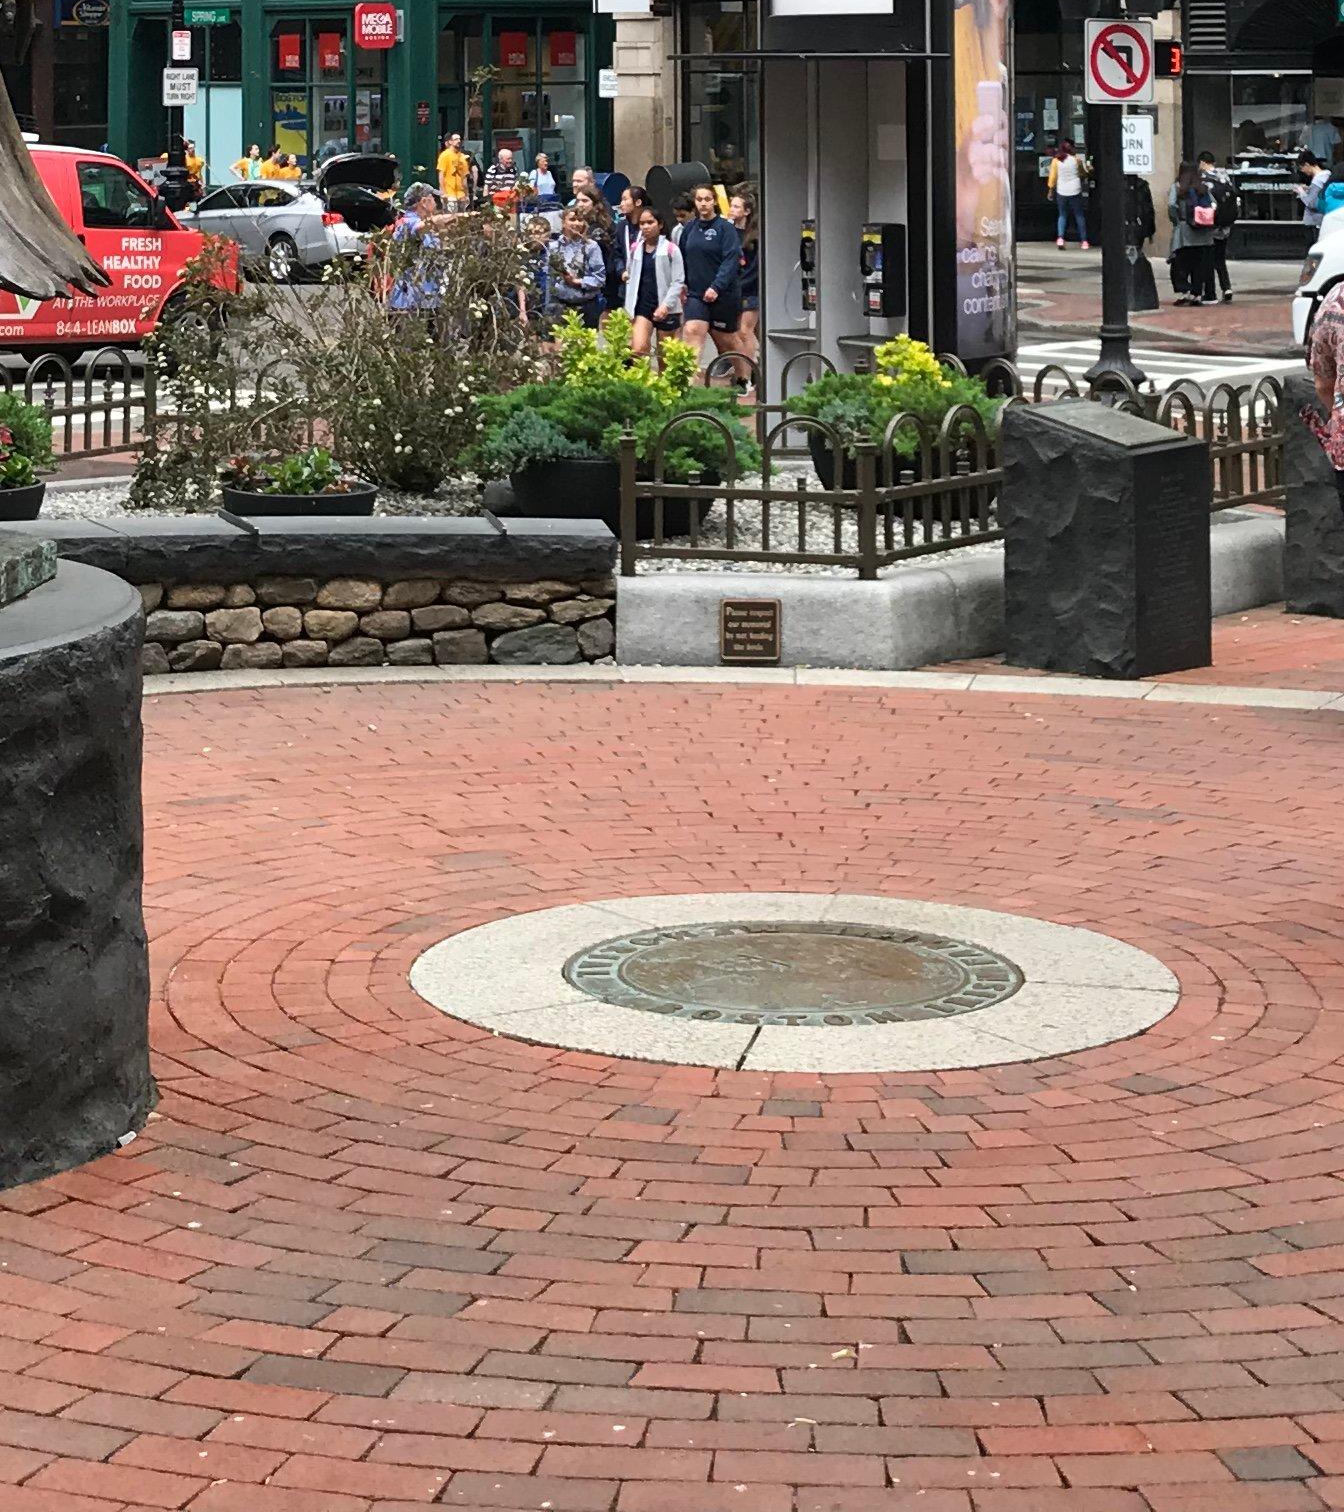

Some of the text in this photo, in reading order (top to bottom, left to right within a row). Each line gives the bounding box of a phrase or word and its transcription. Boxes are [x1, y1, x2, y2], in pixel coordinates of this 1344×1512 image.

[191, 11, 216, 22] SPRING
[361, 12, 392, 24] MEGA
[361, 24, 393, 35] MOBILE
[1170, 46, 1181, 73] 3
[1122, 139, 1143, 149] URN
[1127, 154, 1150, 166] RED
[121, 237, 162, 252] FRESH
[103, 256, 162, 270] HEALTHY
[123, 274, 162, 289] FOOD
[74, 295, 95, 308] THE
[56, 318, 137, 336] 844-LEANBOX
[646, 1001, 905, 1027] BOSTON
